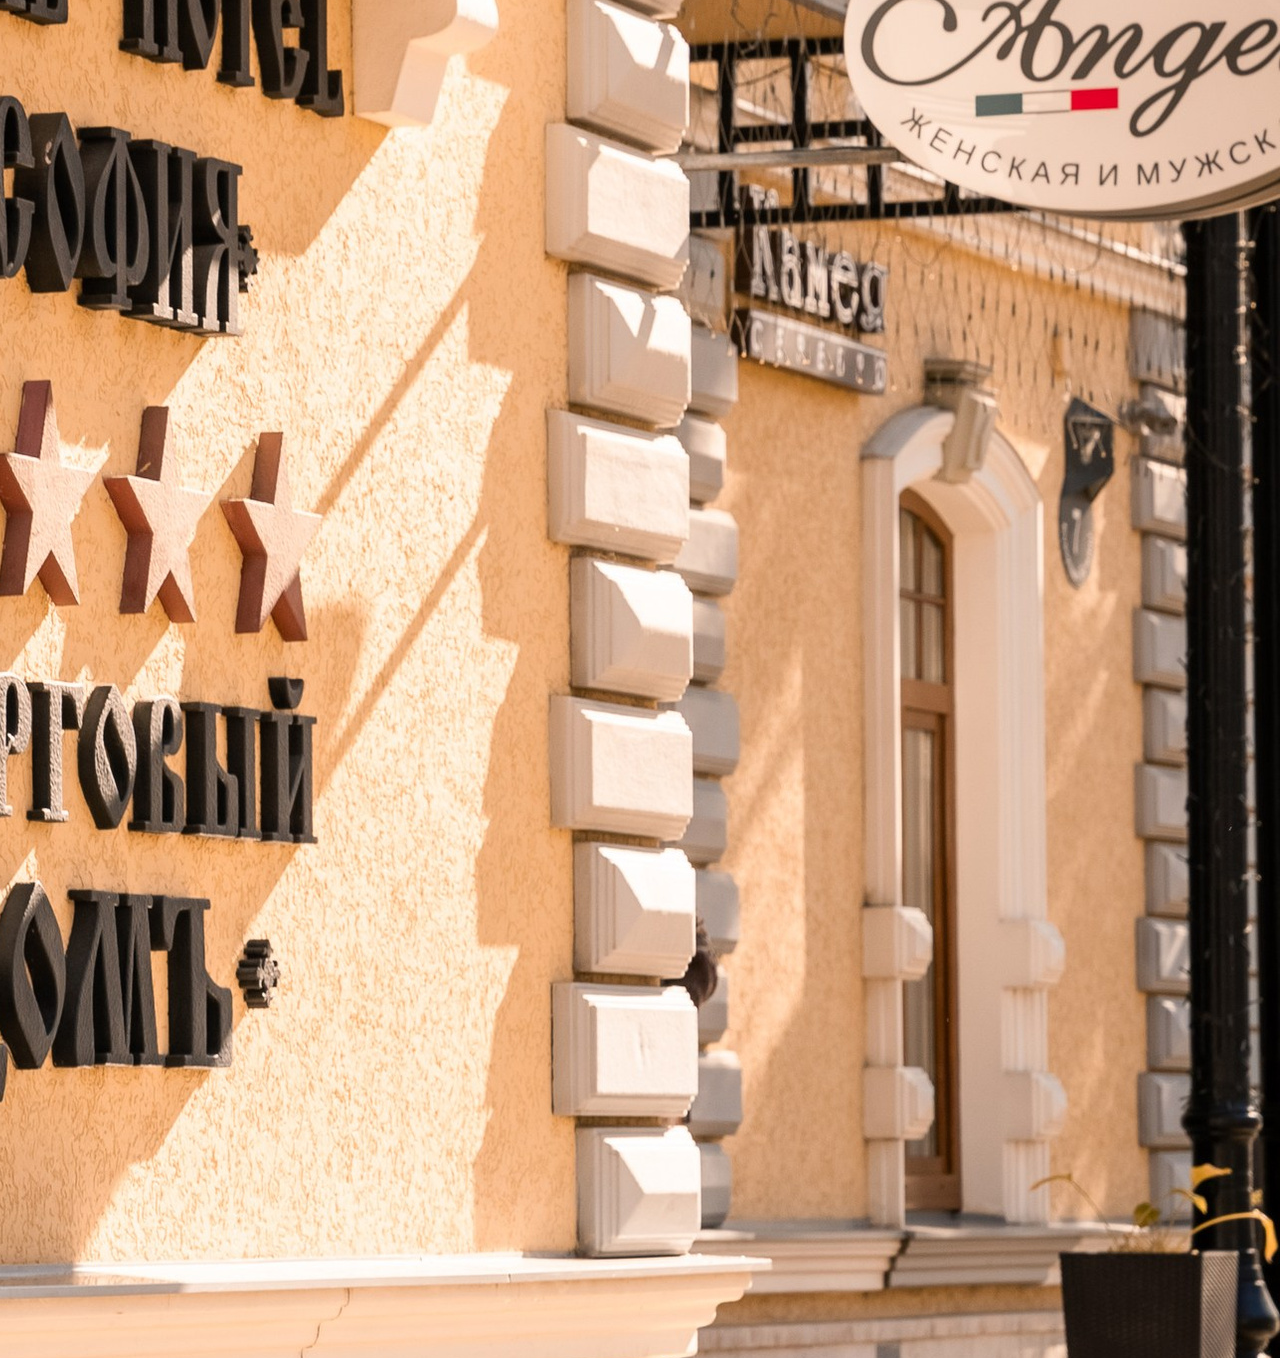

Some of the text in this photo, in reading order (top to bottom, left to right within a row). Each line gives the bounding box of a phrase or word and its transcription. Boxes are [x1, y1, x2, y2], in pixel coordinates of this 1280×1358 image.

[899, 106, 1280, 187] ЖЕНСКАЯ И МУЖСК
